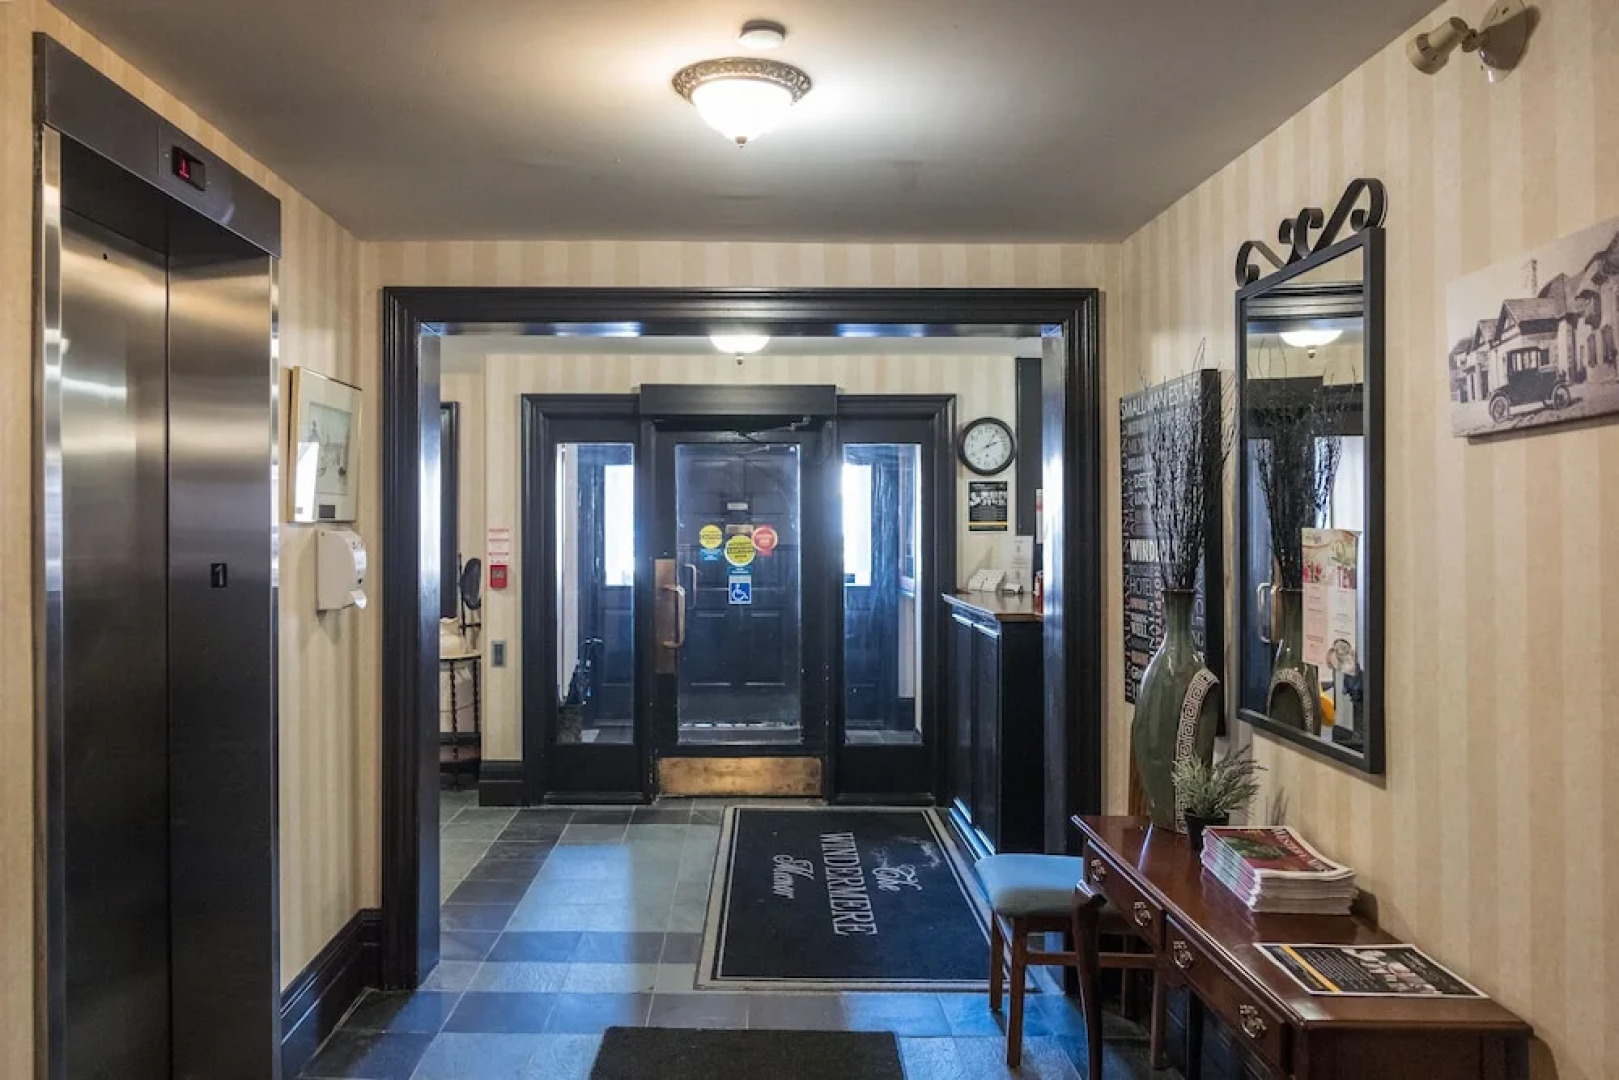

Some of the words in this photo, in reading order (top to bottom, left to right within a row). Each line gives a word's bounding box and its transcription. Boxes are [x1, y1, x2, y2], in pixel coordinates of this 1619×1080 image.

[179, 157, 191, 180] 1
[214, 564, 224, 586] 1
[772, 854, 815, 900] Manor
[819, 831, 878, 936] WINDERMERE
[871, 864, 924, 892] The
